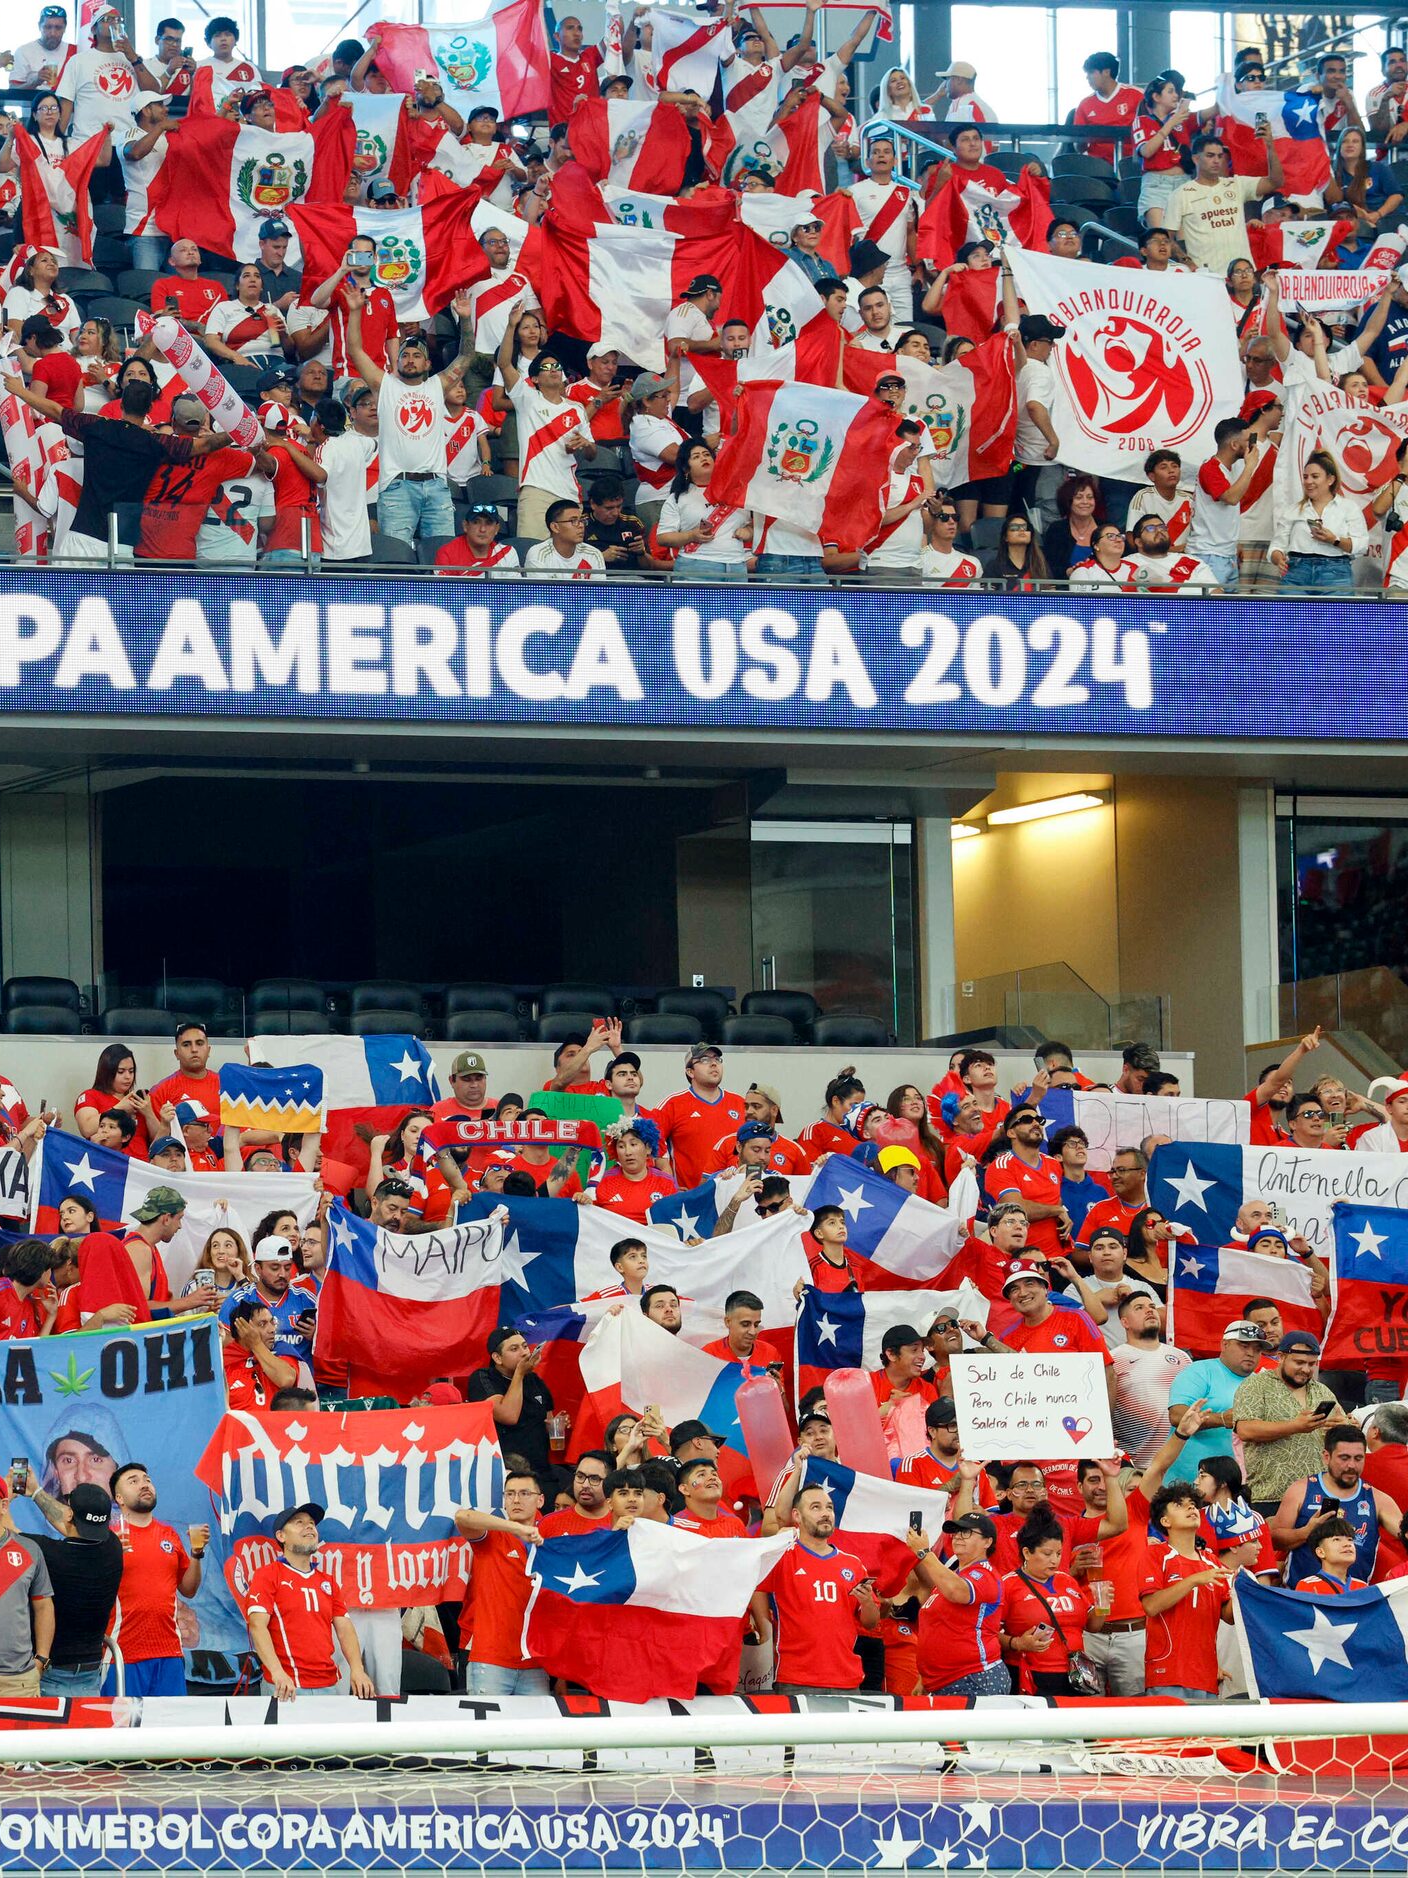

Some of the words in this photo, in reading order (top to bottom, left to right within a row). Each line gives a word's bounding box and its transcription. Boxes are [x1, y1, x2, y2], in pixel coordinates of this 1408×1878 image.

[576, 74, 585, 90] 9
[1200, 206, 1239, 222] apuesta
[1209, 218, 1235, 230] total
[1293, 275, 1370, 301] BLANQUIRROJA
[1118, 437, 1155, 452] 2008
[143, 596, 645, 702] AMERICA
[673, 605, 880, 708] USA
[456, 1119, 580, 1142] CHILE
[1258, 1151, 1389, 1199] Antonella
[99, 1325, 215, 1398] OHI
[1010, 1364, 1024, 1380] de
[1033, 1363, 1061, 1377] Chile
[969, 1391, 993, 1409] Pero
[1004, 1391, 1038, 1407] Chile
[1045, 1394, 1078, 1404] nunca
[971, 1416, 1008, 1430] Saldrá
[1016, 1416, 1030, 1428] de
[1035, 1416, 1048, 1428] mi
[86, 1512, 108, 1523] BOSS
[354, 1551, 375, 1606] y
[301, 1587, 320, 1612] 11
[812, 1579, 837, 1603] 10
[1052, 1597, 1074, 1613] 20
[221, 1813, 338, 1850] COPA
[342, 1812, 530, 1849] AMERICA
[539, 1813, 618, 1850] USA
[1136, 1814, 1266, 1851] VIBRA
[1289, 1814, 1346, 1850] EL
